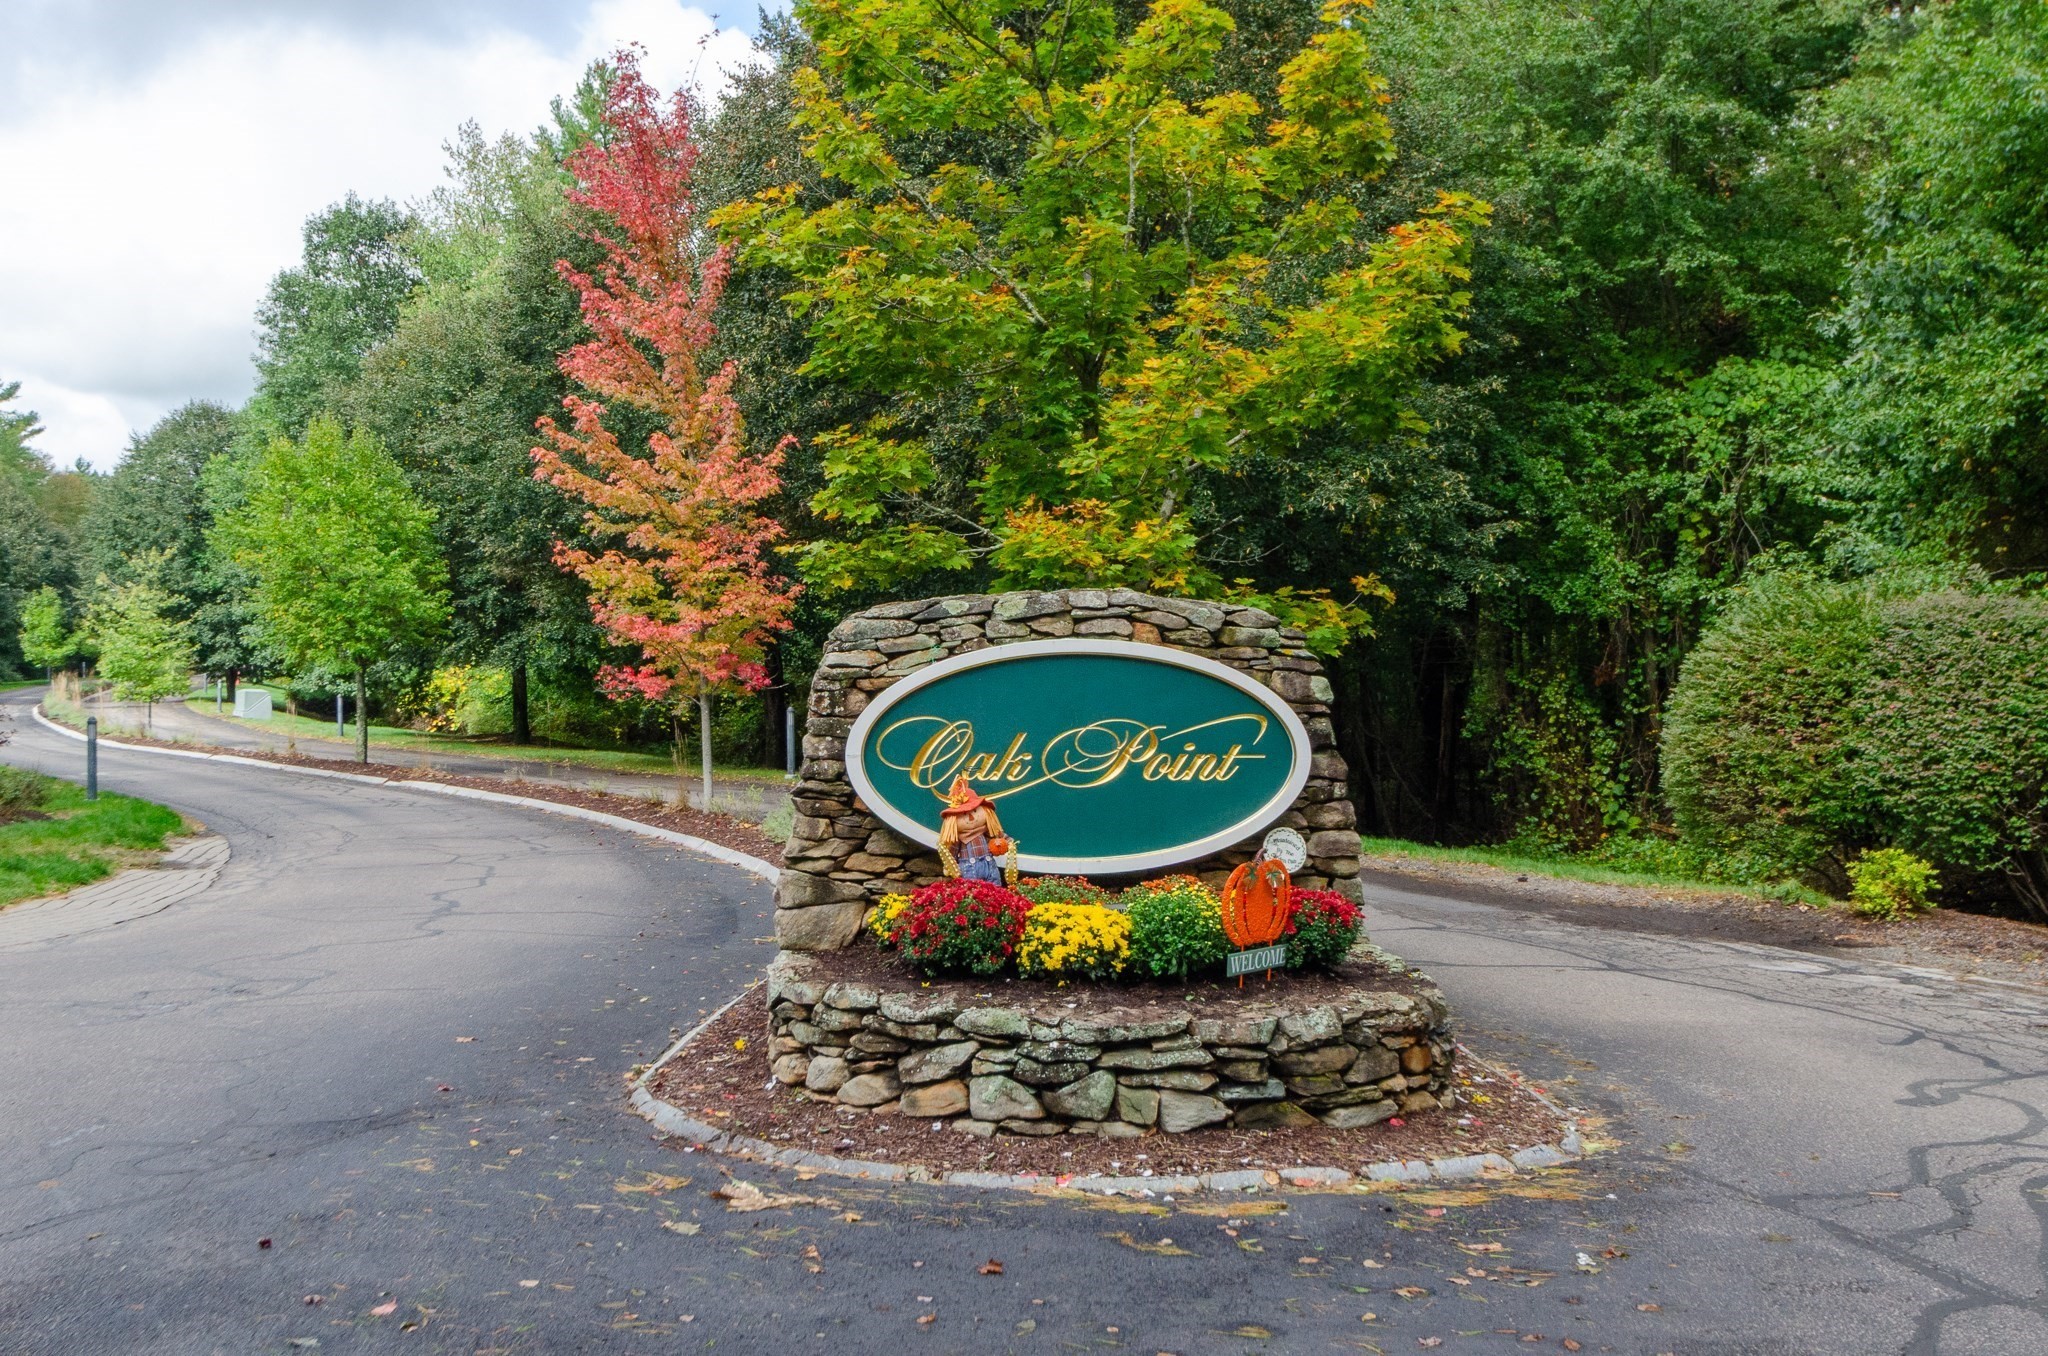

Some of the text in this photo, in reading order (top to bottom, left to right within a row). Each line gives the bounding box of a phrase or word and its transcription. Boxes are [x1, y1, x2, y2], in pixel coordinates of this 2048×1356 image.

[876, 713, 1268, 803] Oak Point
[1230, 947, 1287, 974] WELCOME
